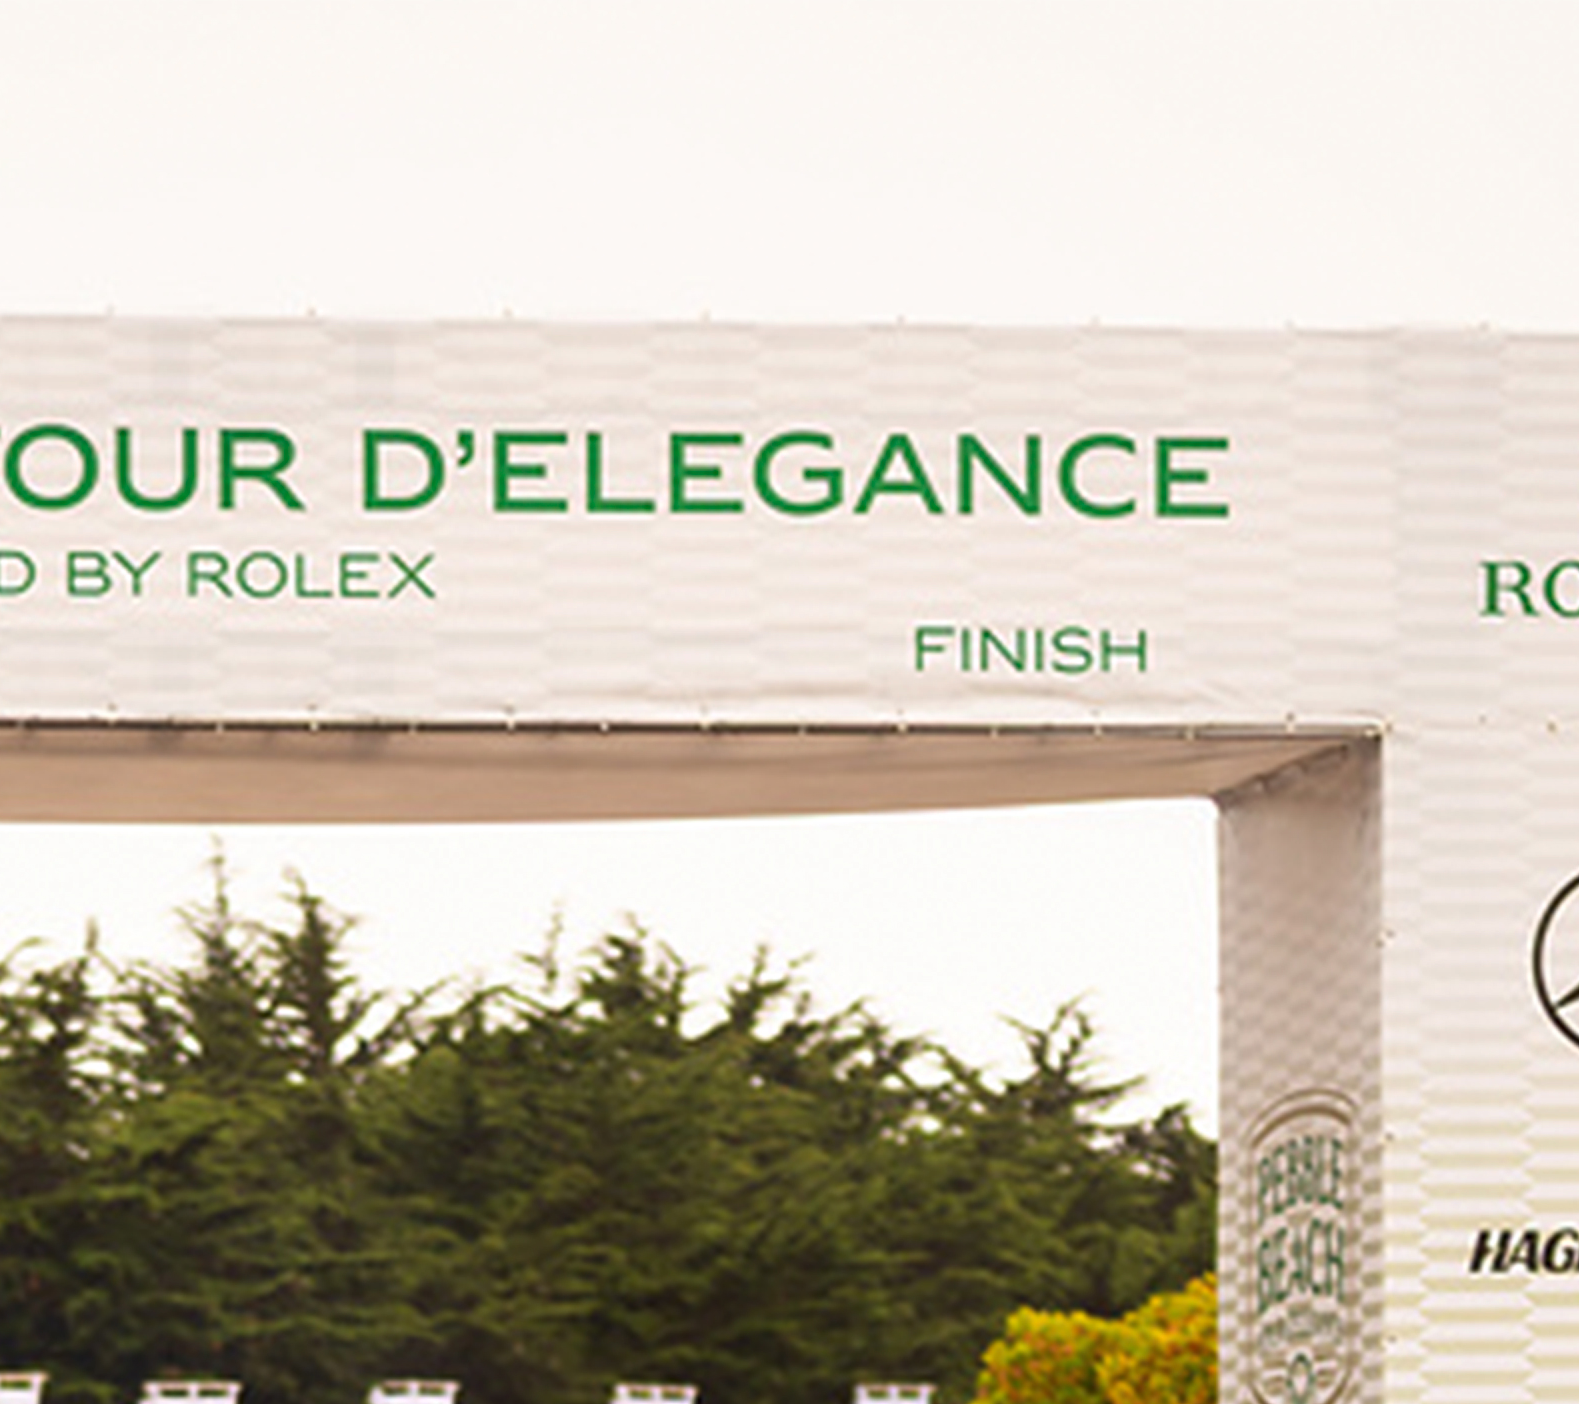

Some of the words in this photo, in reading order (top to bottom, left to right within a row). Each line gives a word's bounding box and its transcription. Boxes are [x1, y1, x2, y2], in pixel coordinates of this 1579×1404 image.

[66, 550, 161, 598] BY
[187, 550, 436, 599] ROLEX
[914, 624, 1148, 675] FINISH
[1258, 1133, 1345, 1228] PEBBLE
[1258, 1216, 1345, 1317] BEACH
